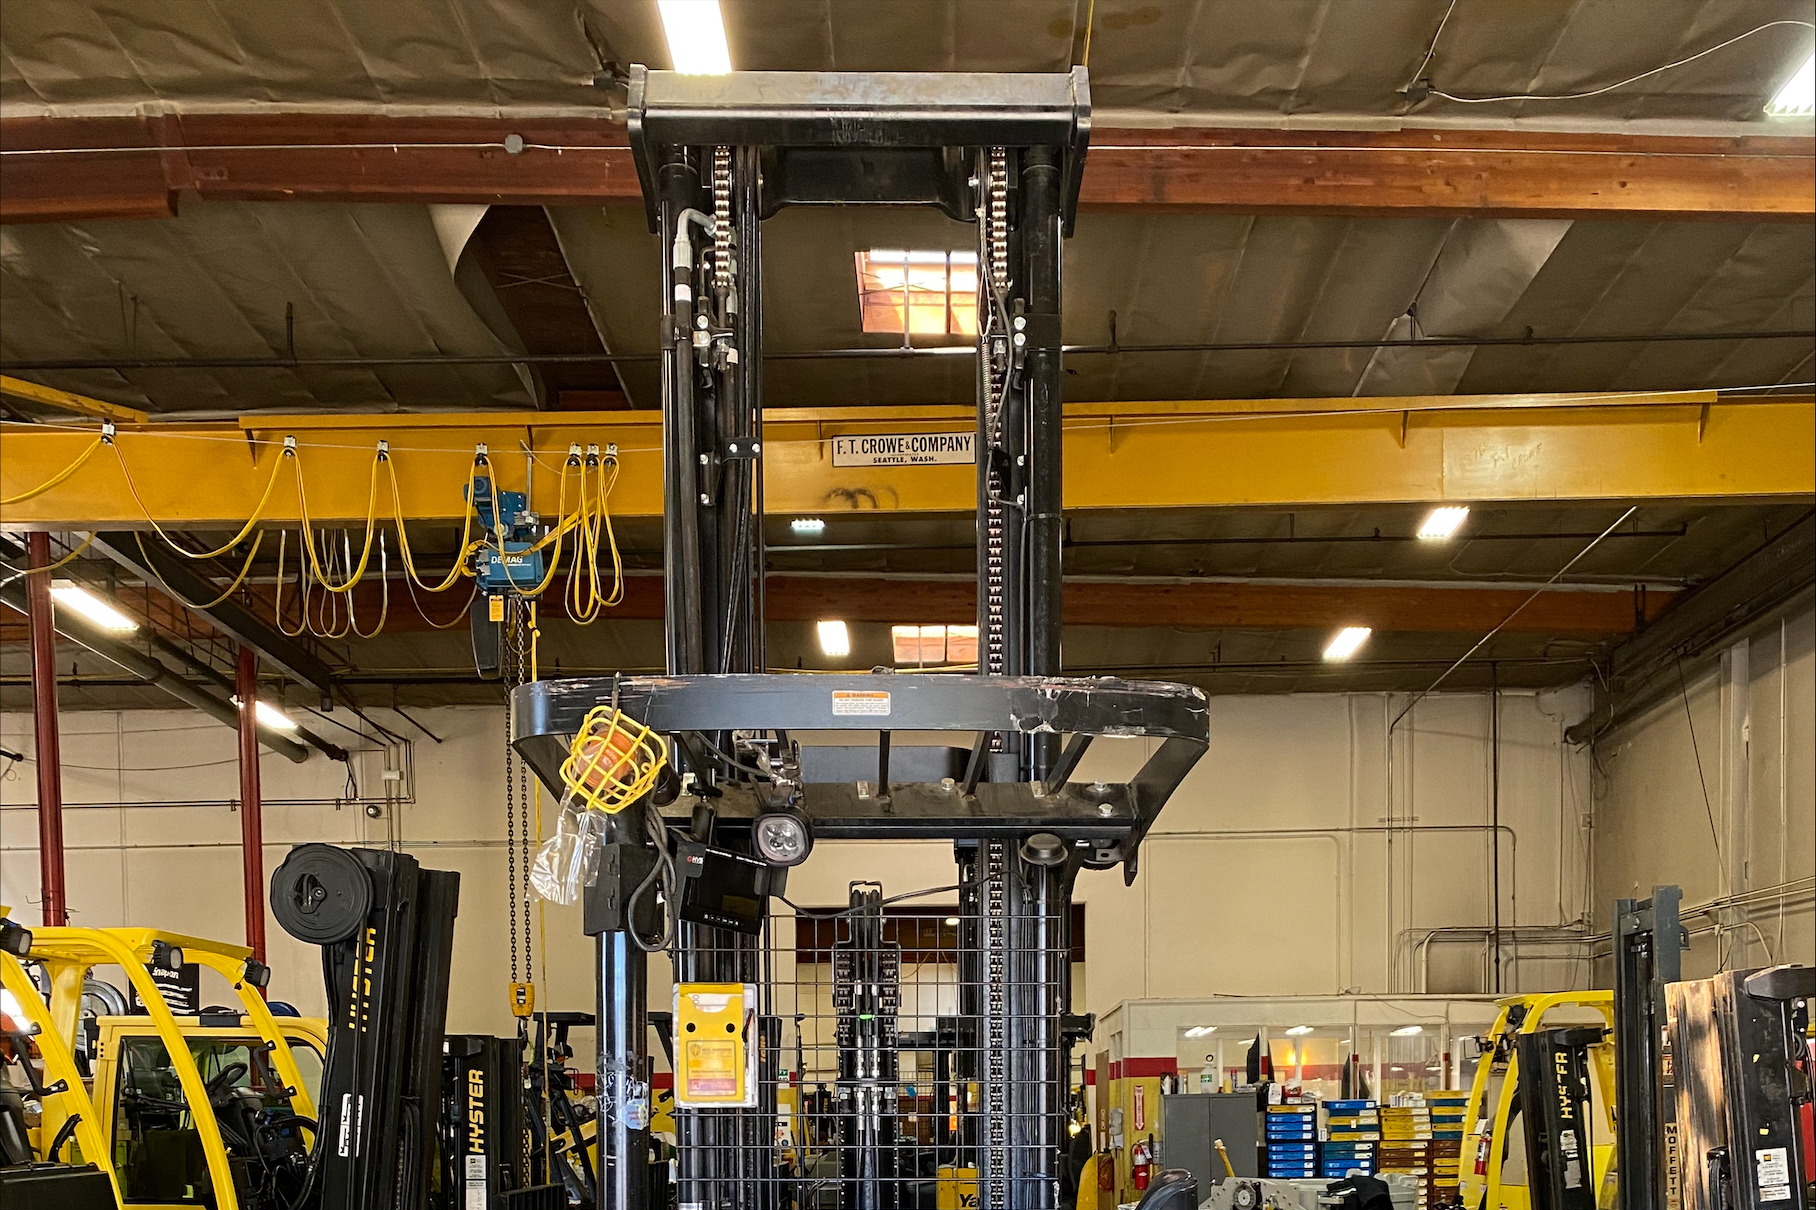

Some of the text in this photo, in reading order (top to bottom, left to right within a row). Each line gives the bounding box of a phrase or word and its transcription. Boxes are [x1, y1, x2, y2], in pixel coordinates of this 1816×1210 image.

[873, 455, 938, 464] SEATTLE, WASH.
[468, 1069, 484, 1154] HYSTER
[1666, 1126, 1678, 1195] MOFFETT
[959, 1193, 980, 1208] Ya
